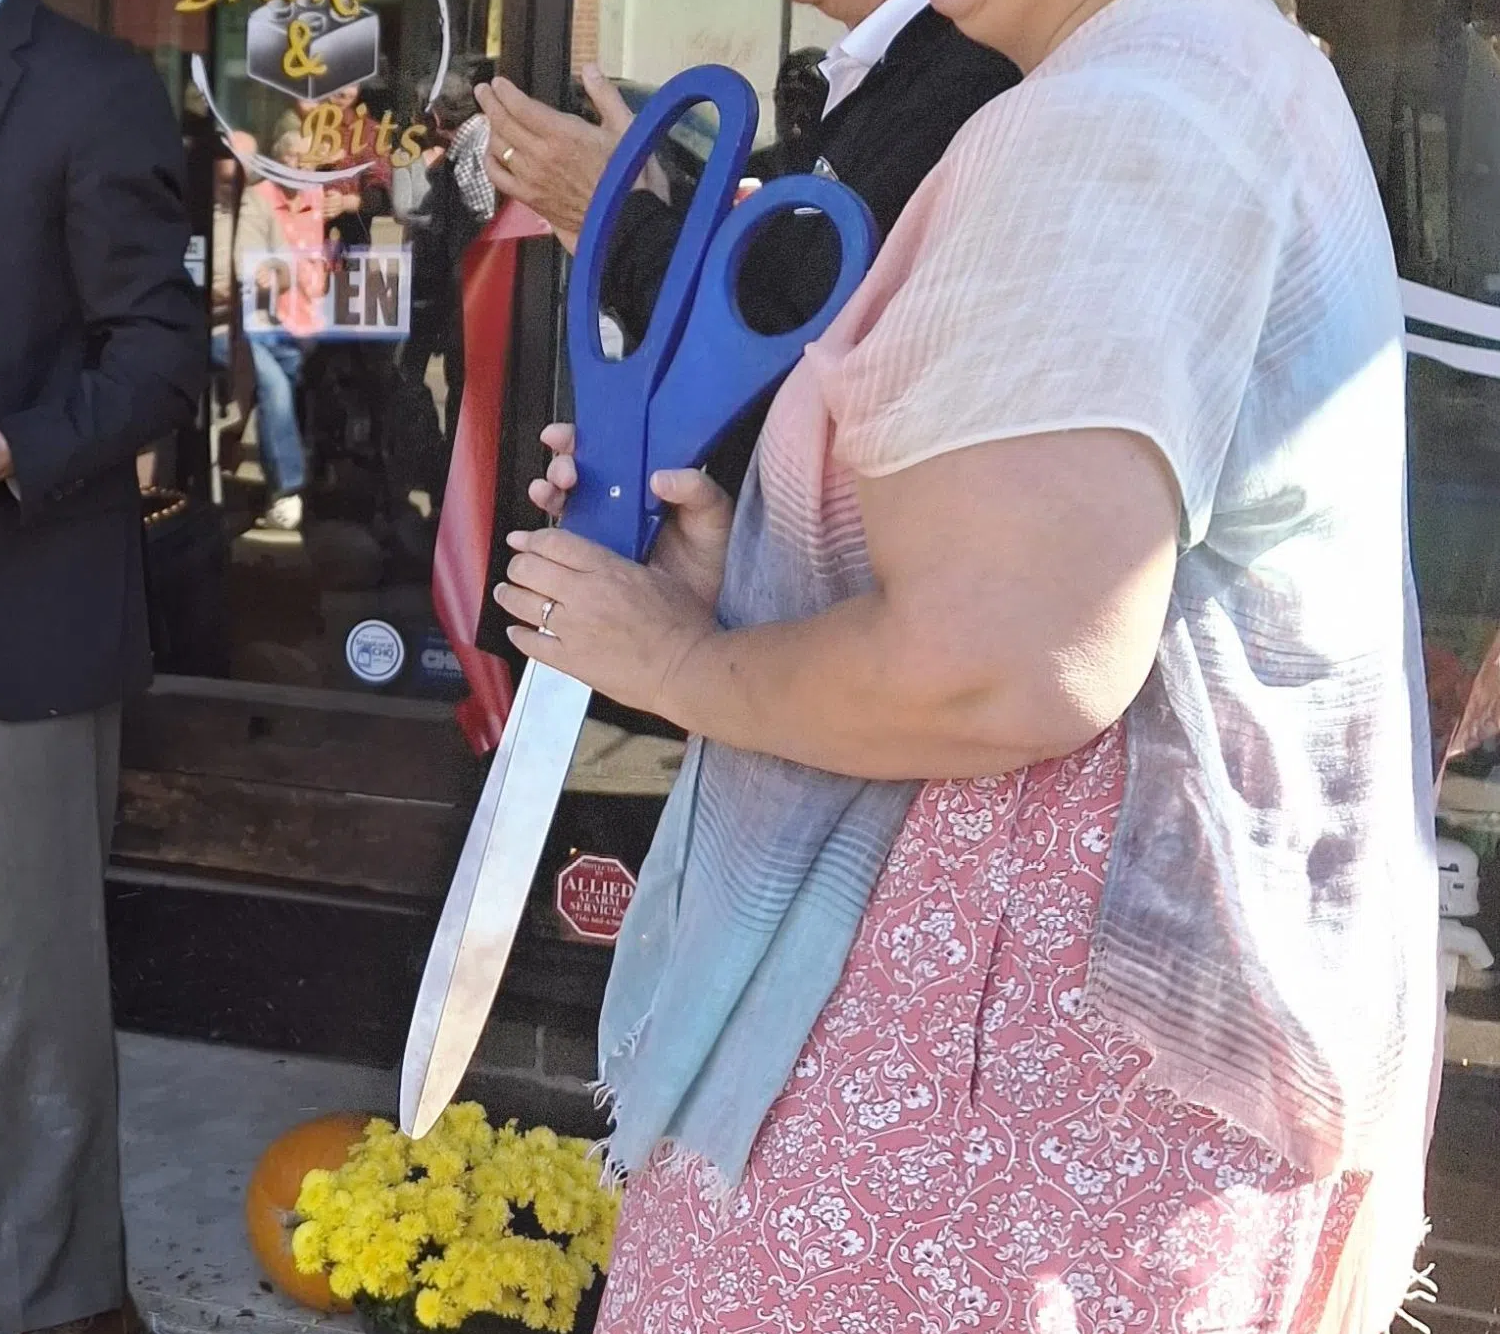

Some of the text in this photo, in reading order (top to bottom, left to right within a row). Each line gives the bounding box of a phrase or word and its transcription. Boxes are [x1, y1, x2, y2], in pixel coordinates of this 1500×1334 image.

[282, 20, 328, 78] &
[300, 101, 429, 168] Bits
[253, 256, 400, 328] OPEN
[564, 874, 634, 899] ALLIED
[578, 891, 620, 908] ALARM
